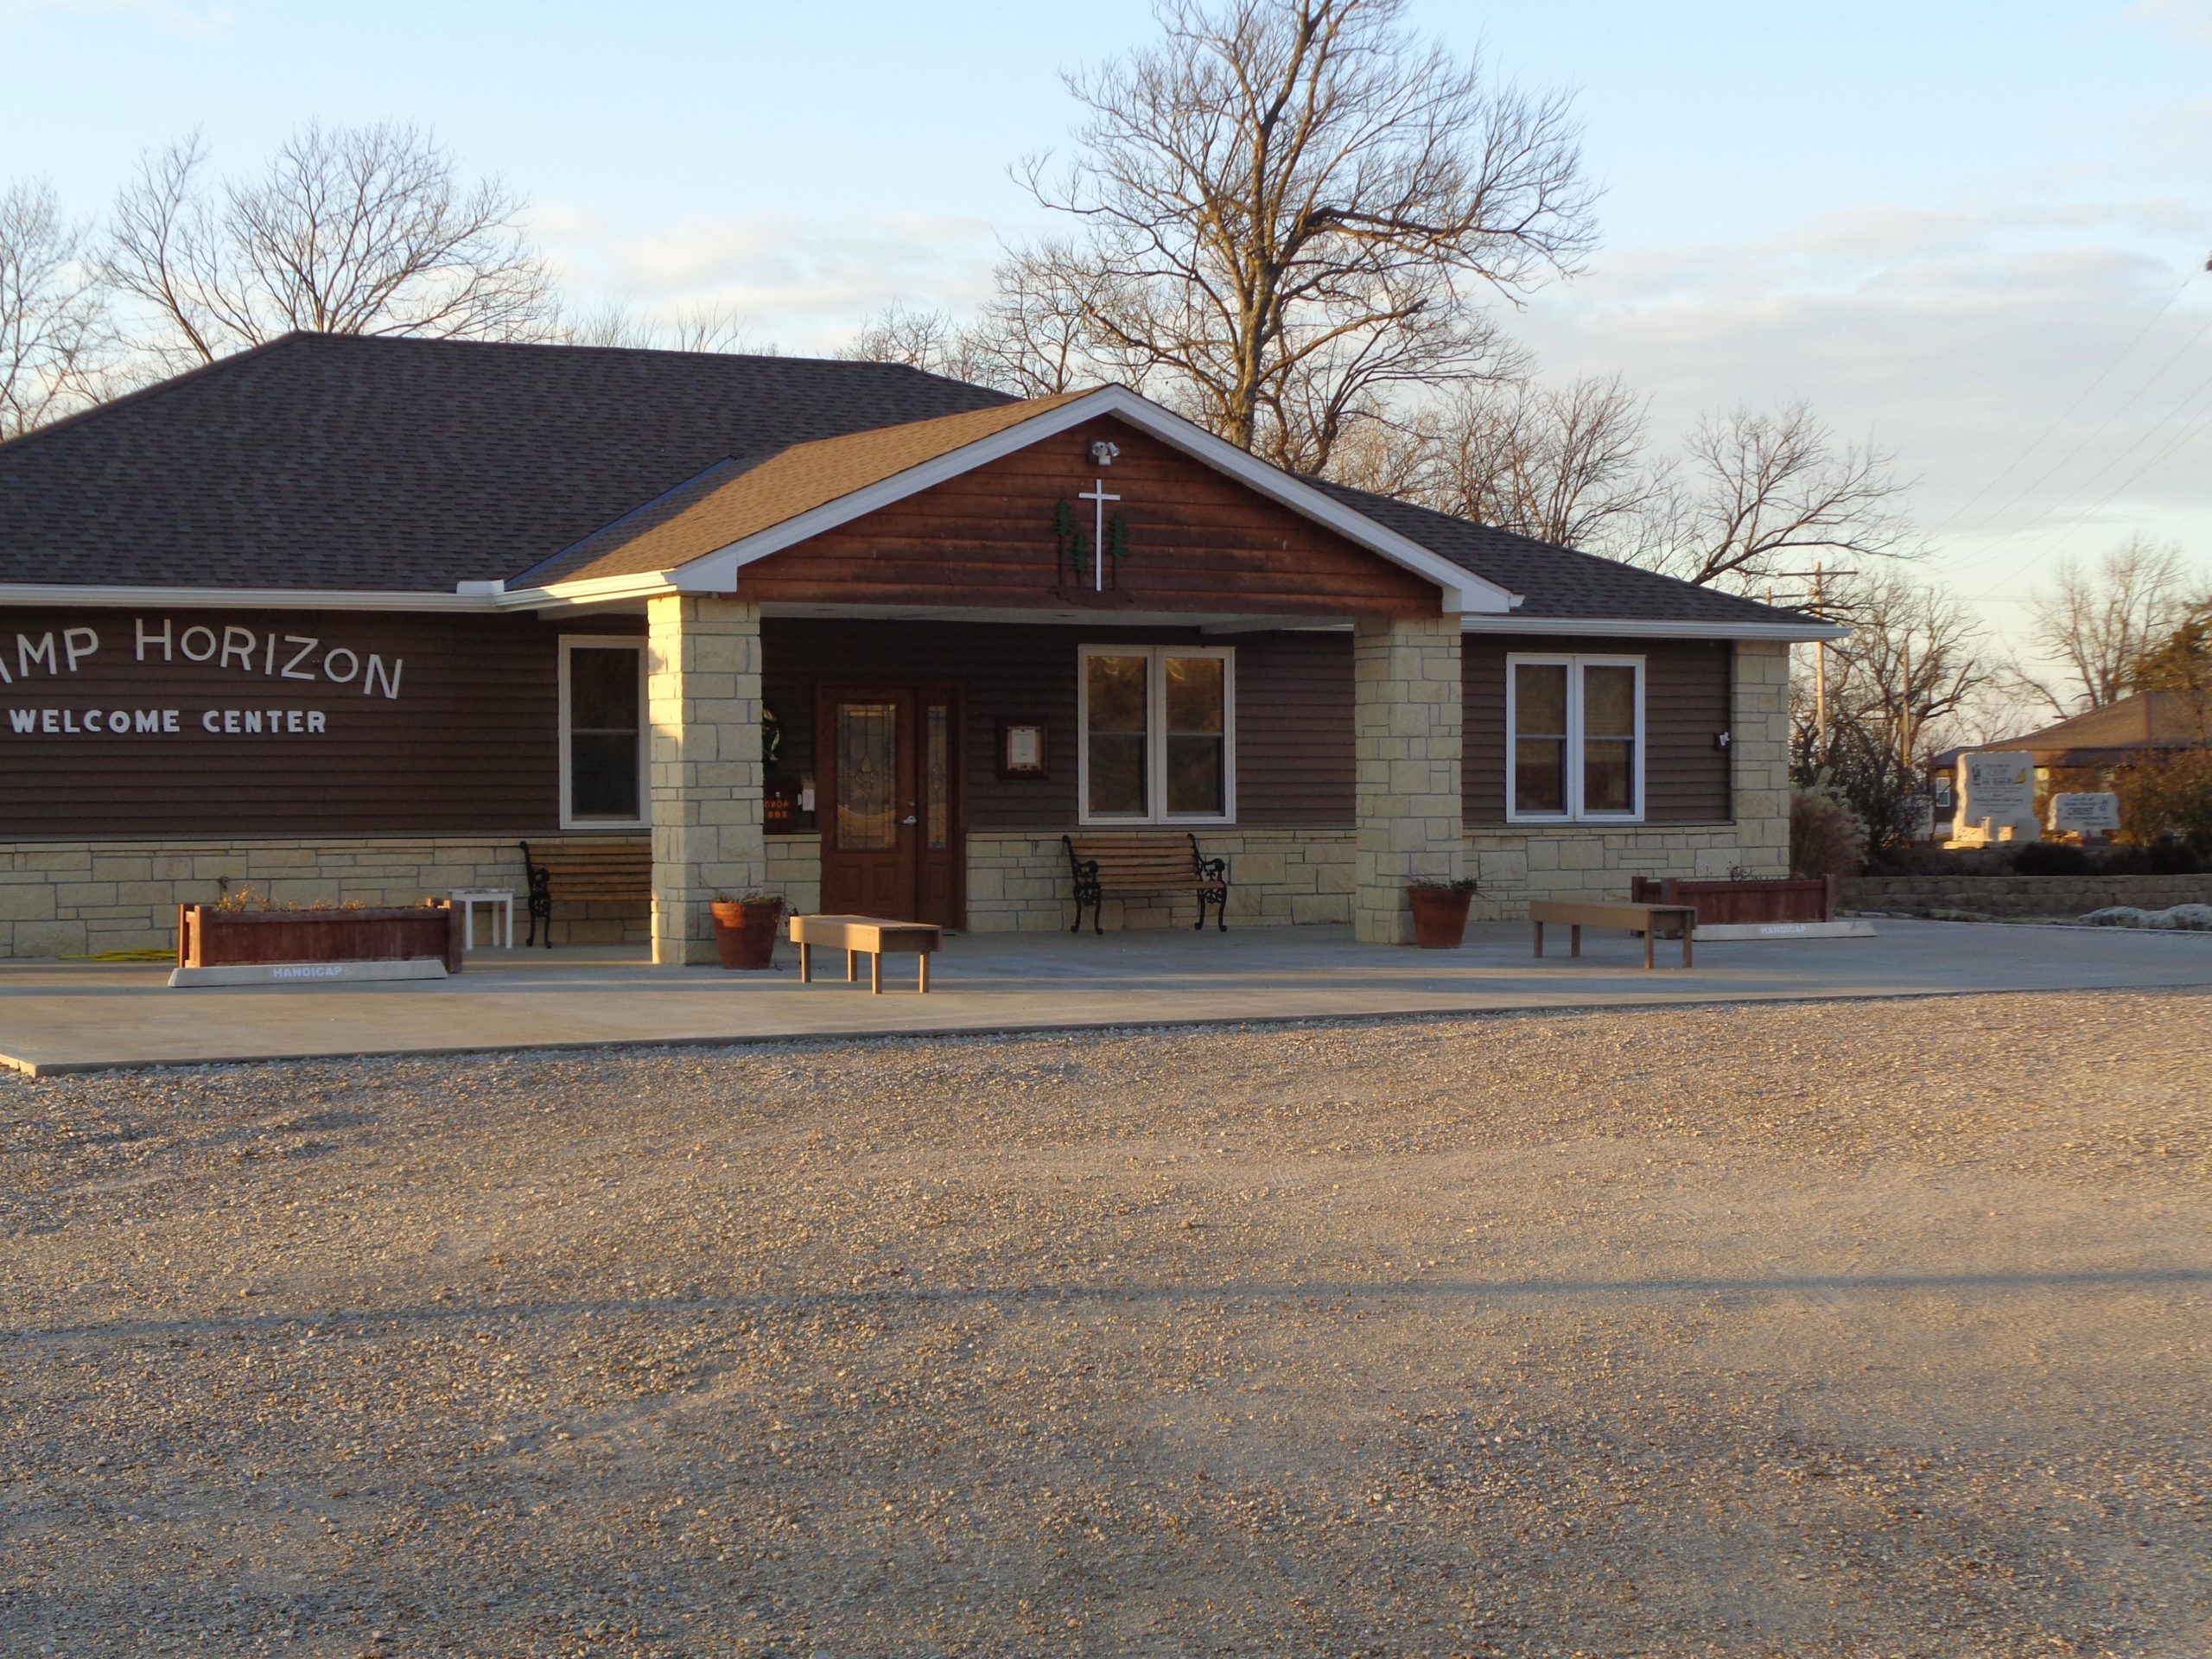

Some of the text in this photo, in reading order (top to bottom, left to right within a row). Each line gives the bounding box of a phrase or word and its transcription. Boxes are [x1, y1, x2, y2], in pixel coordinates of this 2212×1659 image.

[135, 618, 403, 699] HORIZON
[9, 709, 327, 733] WELCOME CENTER
[1761, 925, 1806, 934] HANDICAP
[272, 966, 343, 978] HANDICAP
